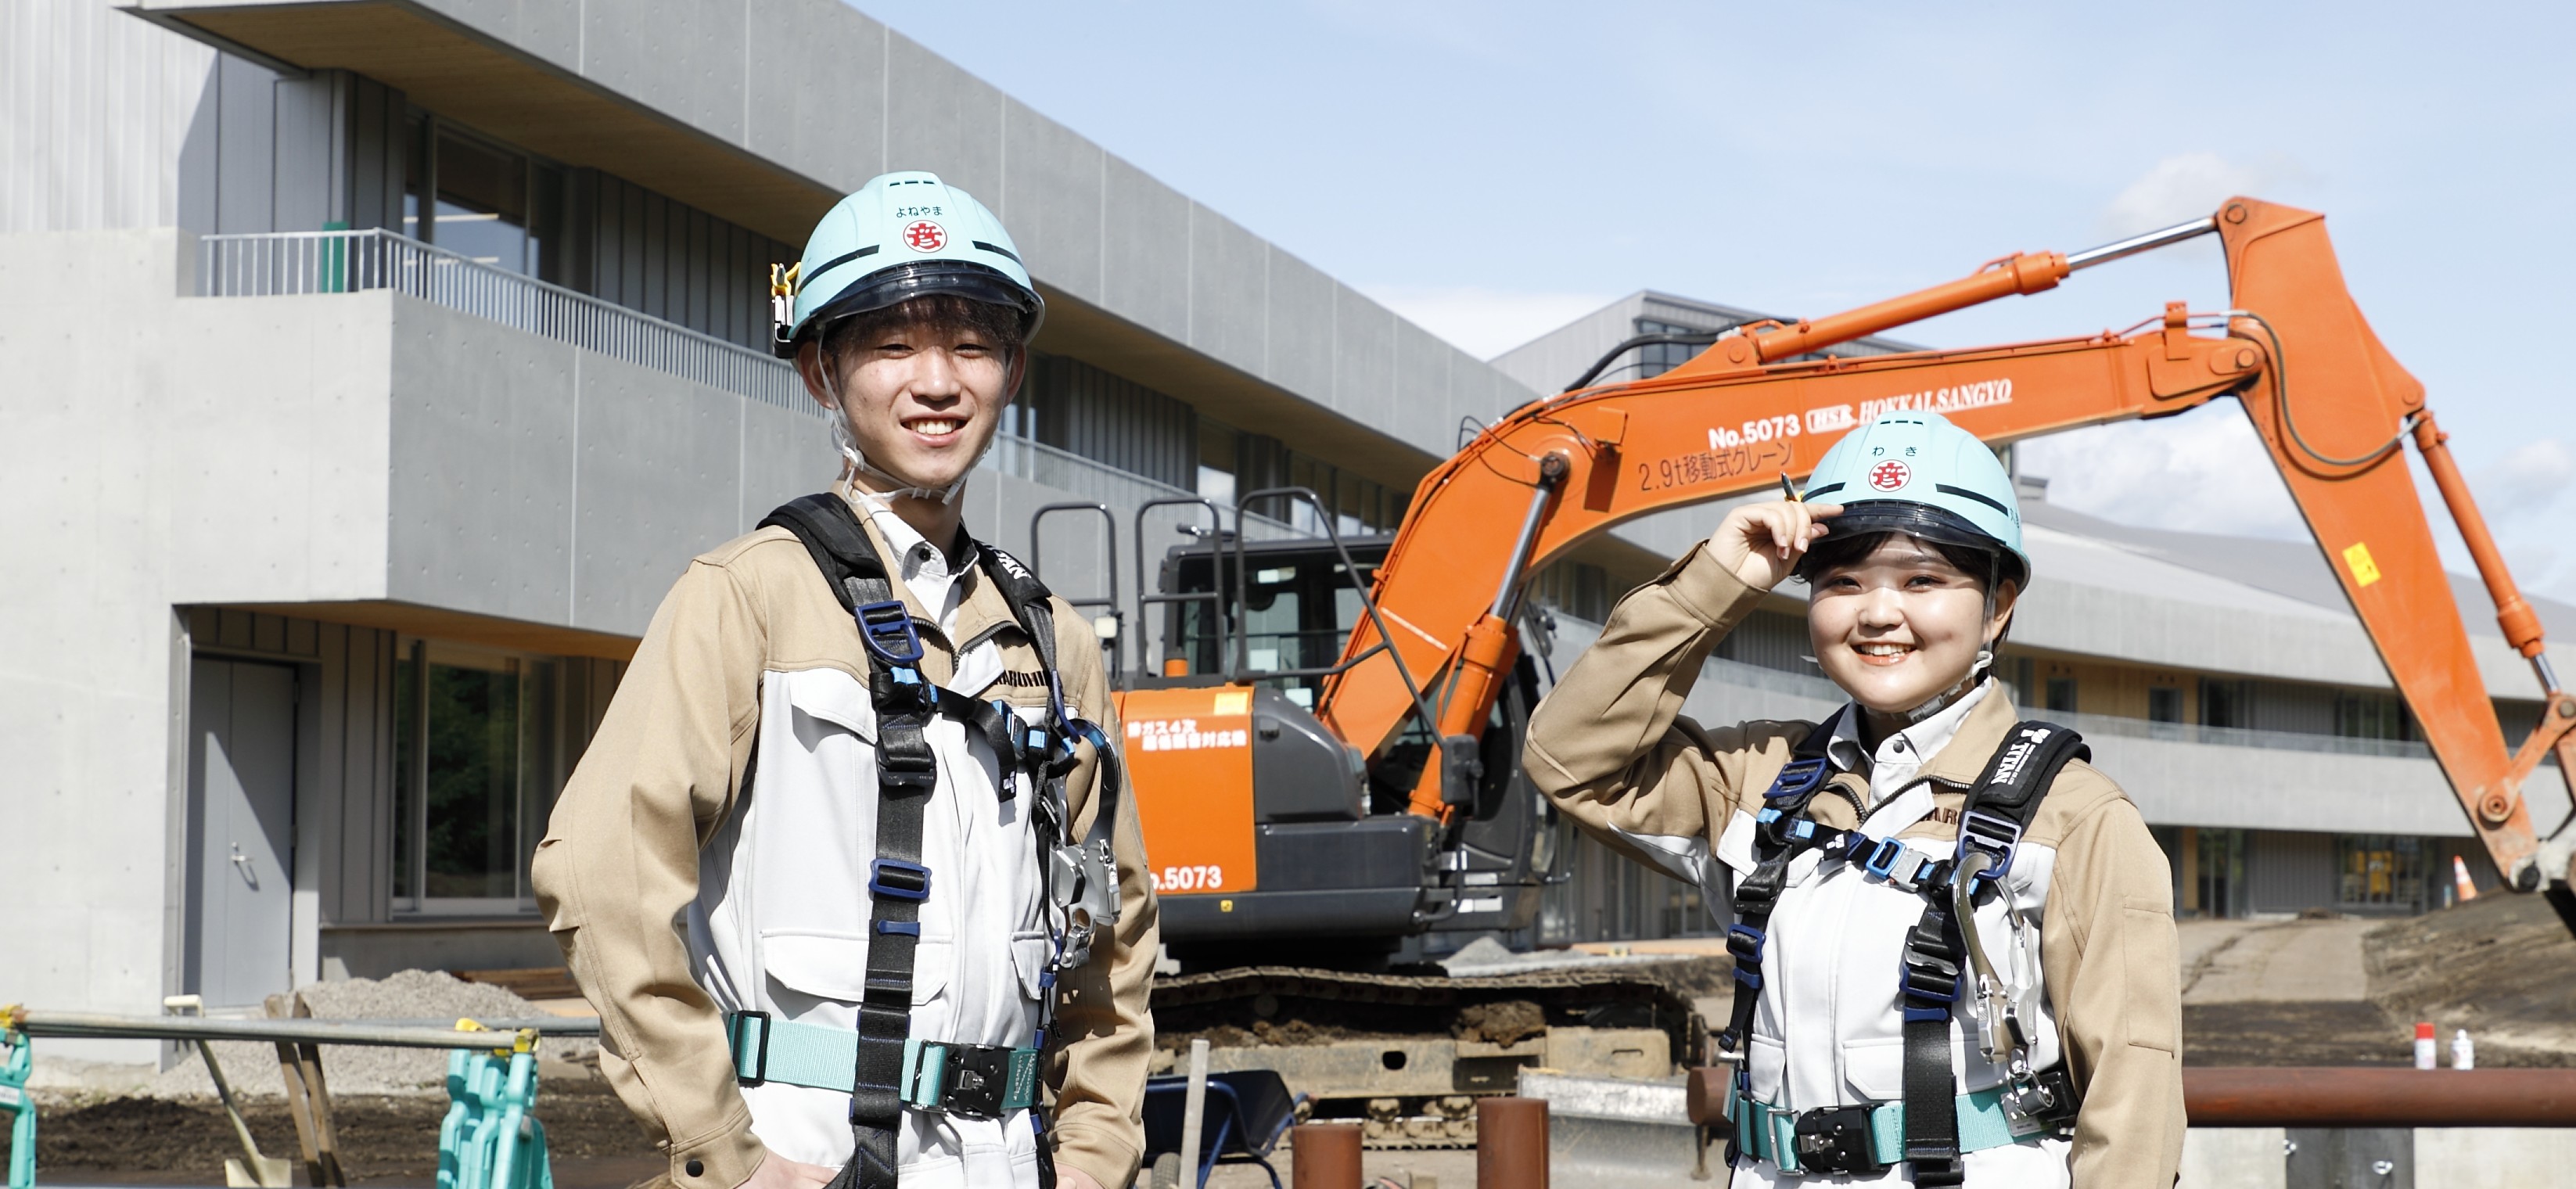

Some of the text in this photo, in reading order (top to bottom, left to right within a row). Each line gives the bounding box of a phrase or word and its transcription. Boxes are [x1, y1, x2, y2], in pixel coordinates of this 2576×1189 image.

[896, 206, 943, 218] よねやま
[1707, 413, 1802, 451] No.5073
[1935, 378, 2013, 410] SANGYO
[1638, 442, 1793, 492] 2.9t移動式クレーン
[1990, 742, 2031, 785] TITAN
[1149, 864, 1223, 891] o.5073
